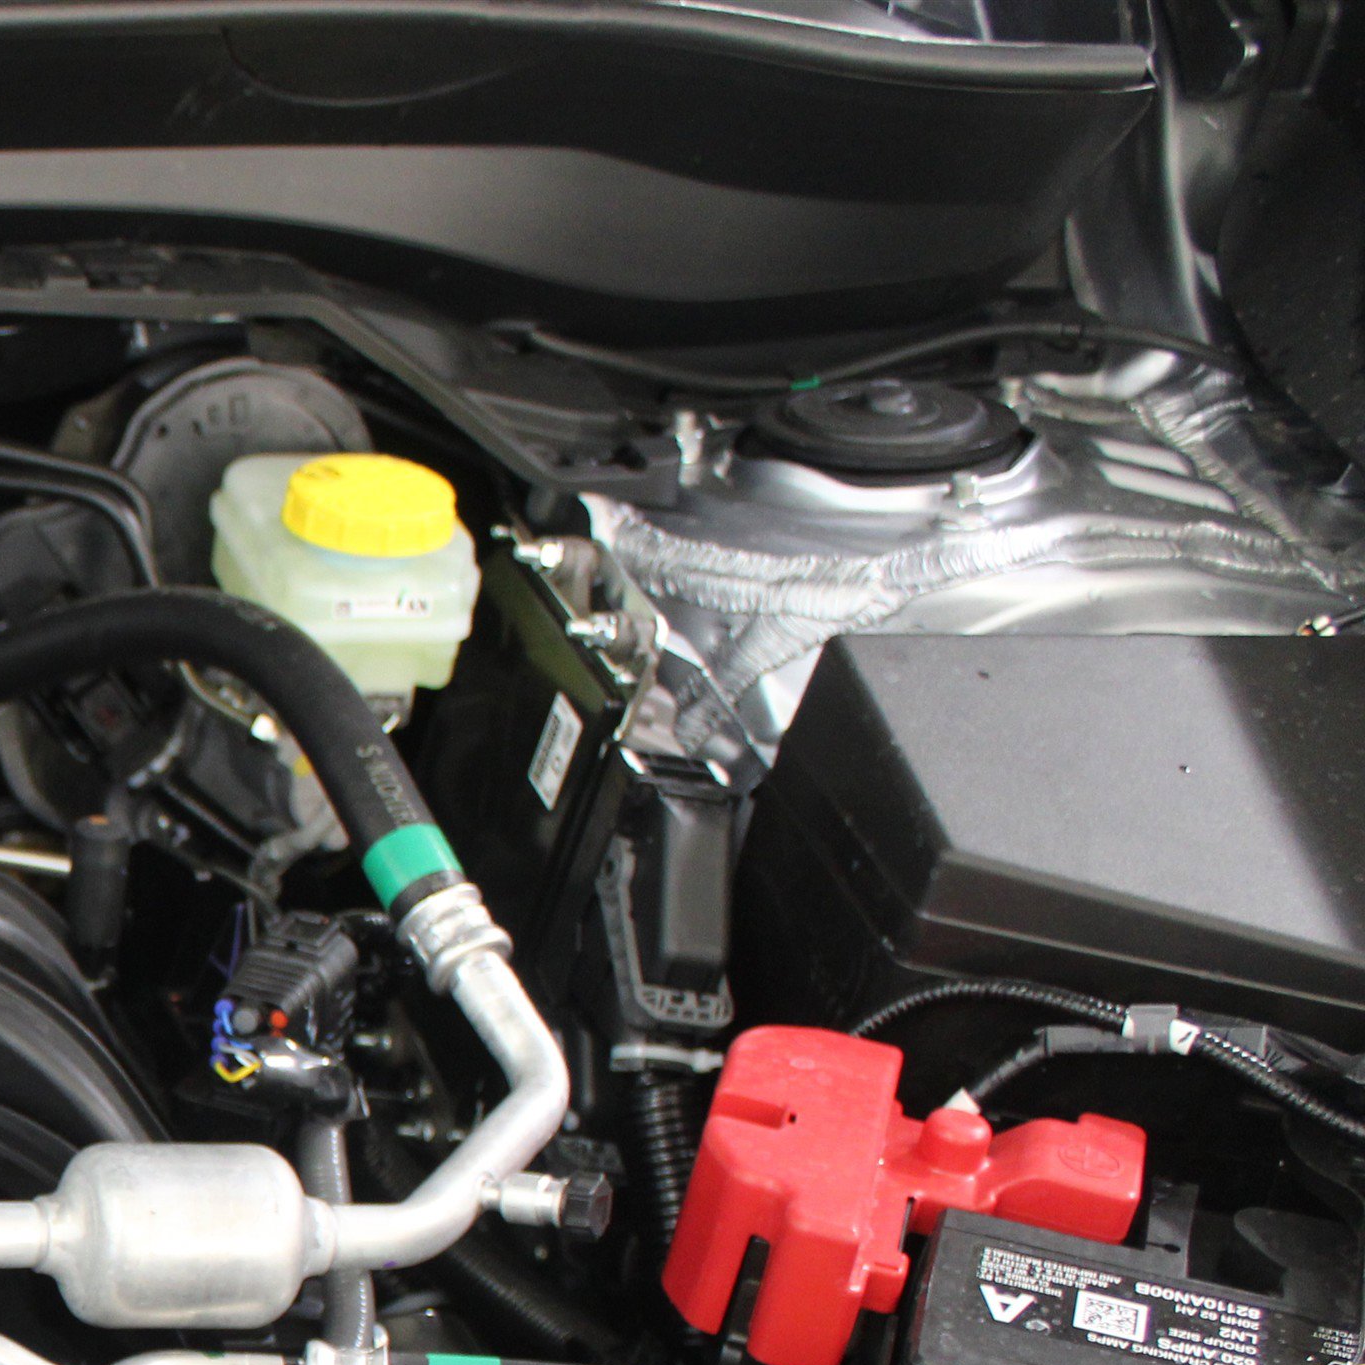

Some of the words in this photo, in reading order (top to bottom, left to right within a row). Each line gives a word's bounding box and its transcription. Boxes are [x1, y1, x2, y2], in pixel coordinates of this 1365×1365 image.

[1174, 1304, 1197, 1316] AH
[1199, 1308, 1219, 1321] 62
[1220, 1313, 1260, 1331] 20HR
[1086, 1332, 1129, 1350] AMPS
[1167, 1327, 1201, 1342] SIZE
[1218, 1326, 1258, 1344] LN2
[1156, 1336, 1217, 1360] AMPS
[1203, 1336, 1258, 1355] GROUP
